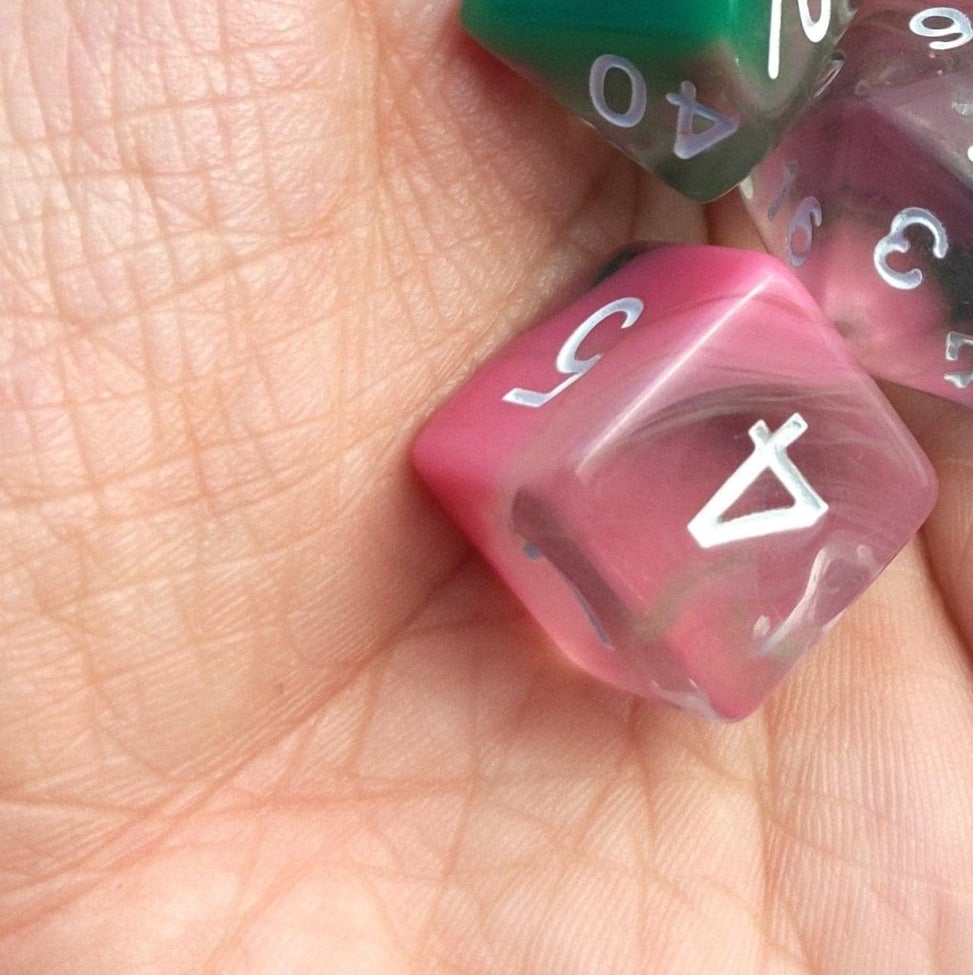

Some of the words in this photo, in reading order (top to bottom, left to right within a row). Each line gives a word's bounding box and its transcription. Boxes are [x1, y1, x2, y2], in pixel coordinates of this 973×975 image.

[873, 207, 948, 290] 3
[502, 297, 644, 408] 5
[687, 412, 830, 549] 4
